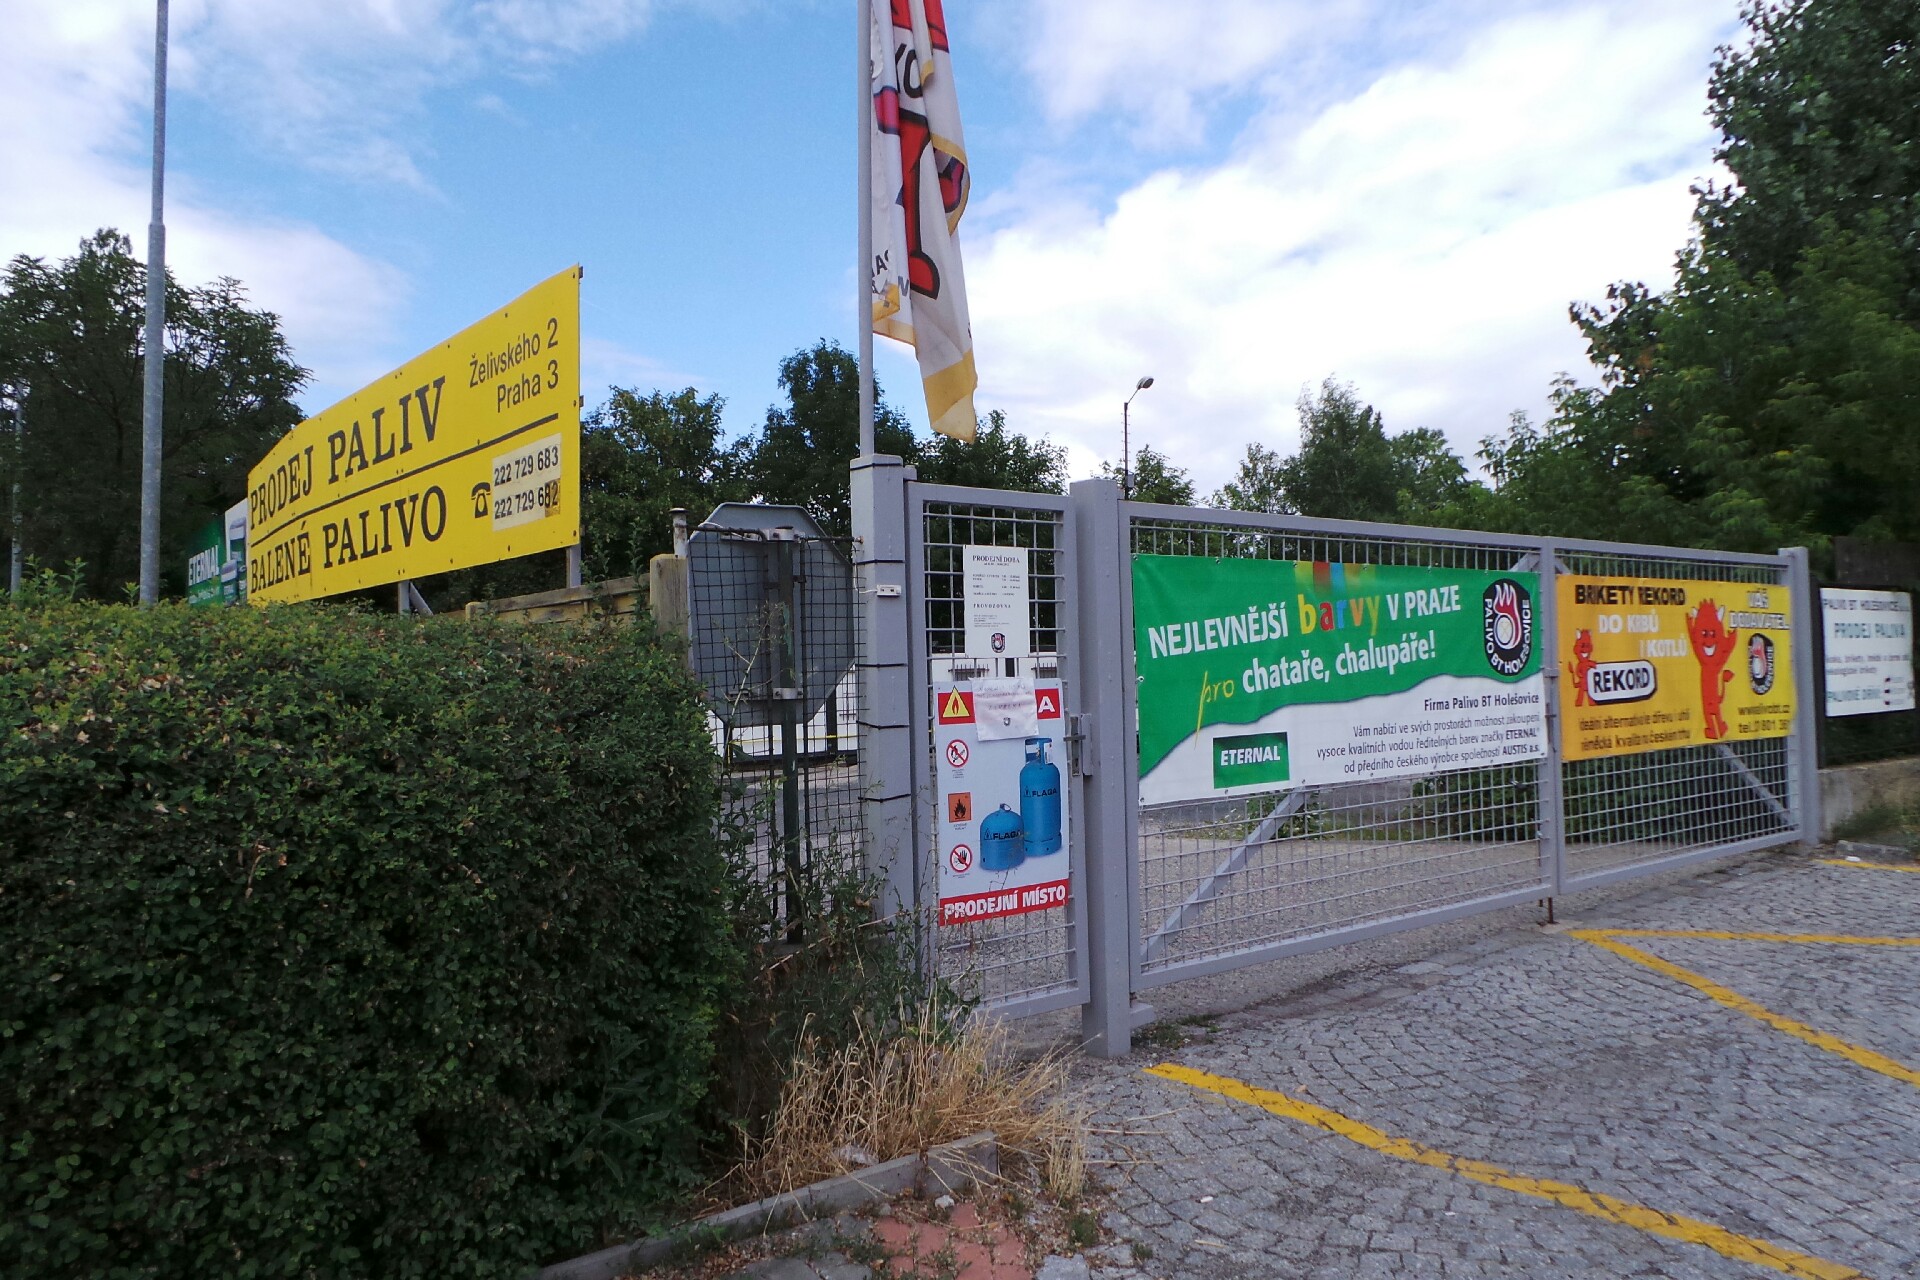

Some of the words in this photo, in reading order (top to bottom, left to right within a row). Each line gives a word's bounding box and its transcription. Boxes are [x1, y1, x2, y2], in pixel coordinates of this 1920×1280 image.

[470, 333, 540, 388] Želivského
[547, 317, 558, 349] 2
[497, 373, 541, 413] Praha
[547, 359, 558, 390] 3
[250, 445, 313, 530] PRODEJ
[327, 375, 445, 485] PALIV
[494, 462, 512, 487] 222
[514, 455, 533, 479] 729
[537, 446, 558, 471] 683
[494, 495, 512, 520] 222
[514, 489, 534, 512] 729
[537, 480, 558, 508] 682
[250, 520, 311, 594] BALENÉ
[322, 486, 446, 568] PALIVO
[1574, 584, 1633, 605] BRIKETY
[1637, 586, 1685, 606] REKORD
[1148, 601, 1289, 659] NEJLEVNĚJŠÍ
[1297, 593, 1380, 636] barvy
[1386, 594, 1399, 620] V
[1404, 584, 1461, 618] PRAZE
[1484, 598, 1495, 654] PALIVO
[1598, 614, 1623, 634] DO
[1194, 671, 1235, 735] pro
[1242, 650, 1331, 693] chataře,
[1335, 629, 1437, 675] chalupáře!
[1592, 666, 1651, 694] REKORD
[1424, 698, 1450, 711] Firma
[1452, 695, 1479, 710] Palivo
[1482, 695, 1492, 708] BT
[1494, 691, 1540, 707] Holešovice
[1353, 724, 1372, 738] Vám
[1399, 724, 1409, 734] ve
[1411, 719, 1432, 735] svých
[1434, 717, 1473, 736] prostorách
[1220, 745, 1281, 766] ETERNAL
[1317, 746, 1346, 762] vysoce
[1388, 740, 1414, 752] vodou
[1459, 733, 1480, 745] barev
[1344, 763, 1356, 775] od
[1396, 751, 1430, 768] českého
[1430, 749, 1460, 768] výrobce
[1032, 788, 1057, 798] FLAGA
[943, 890, 1019, 920] PRODEJNÍ
[1022, 885, 1066, 908] MÍSTO
